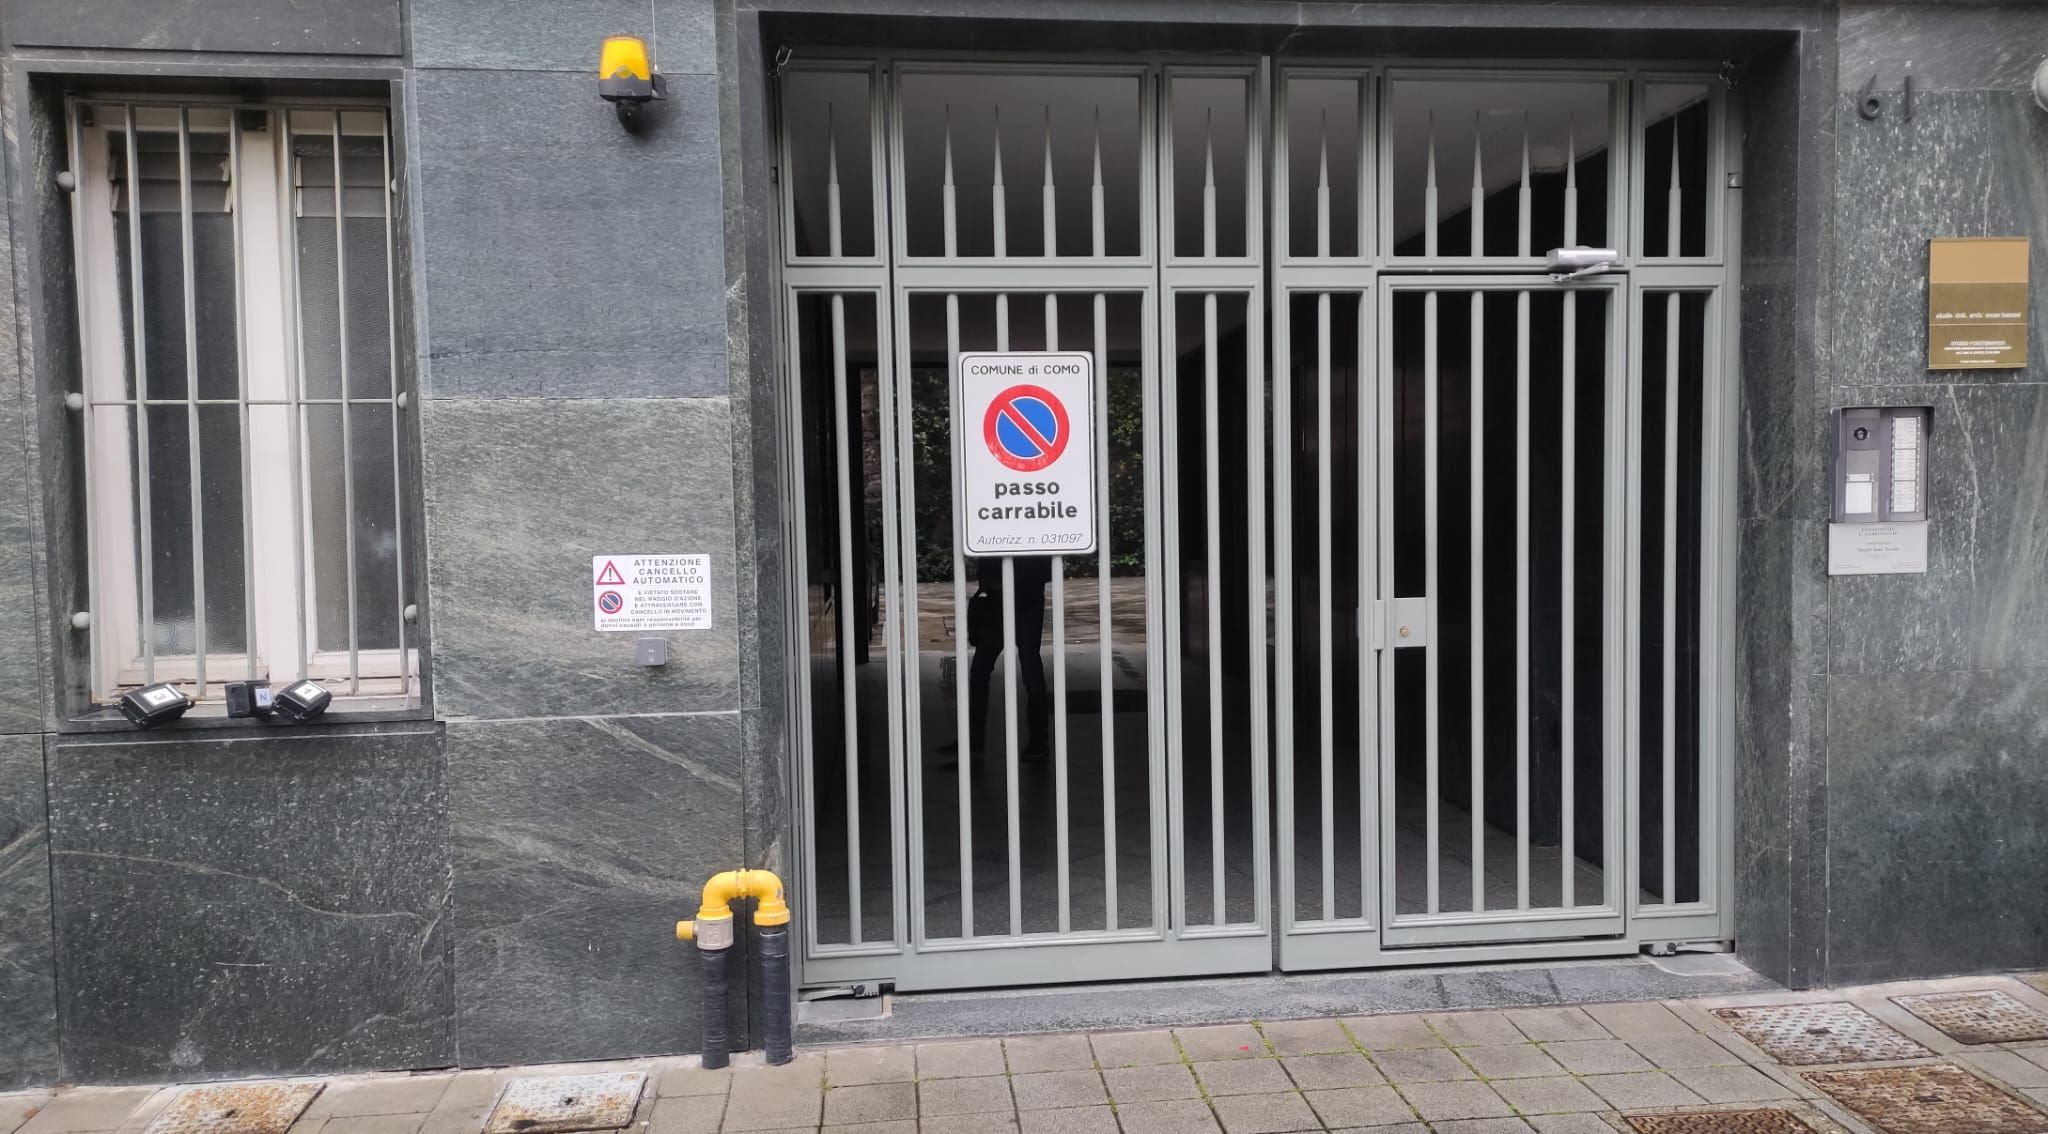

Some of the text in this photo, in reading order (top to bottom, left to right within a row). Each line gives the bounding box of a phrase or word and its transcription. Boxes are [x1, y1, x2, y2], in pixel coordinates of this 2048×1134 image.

[971, 364, 1080, 375] COMUNE di COMO
[994, 481, 1060, 499] passo
[978, 501, 1077, 520] carrabile
[977, 533, 1083, 545] Autorizz. n. 031097
[634, 558, 702, 566] ATTENZIONE
[638, 567, 697, 575] CANCELLO
[633, 576, 704, 584] AUTOMATICO
